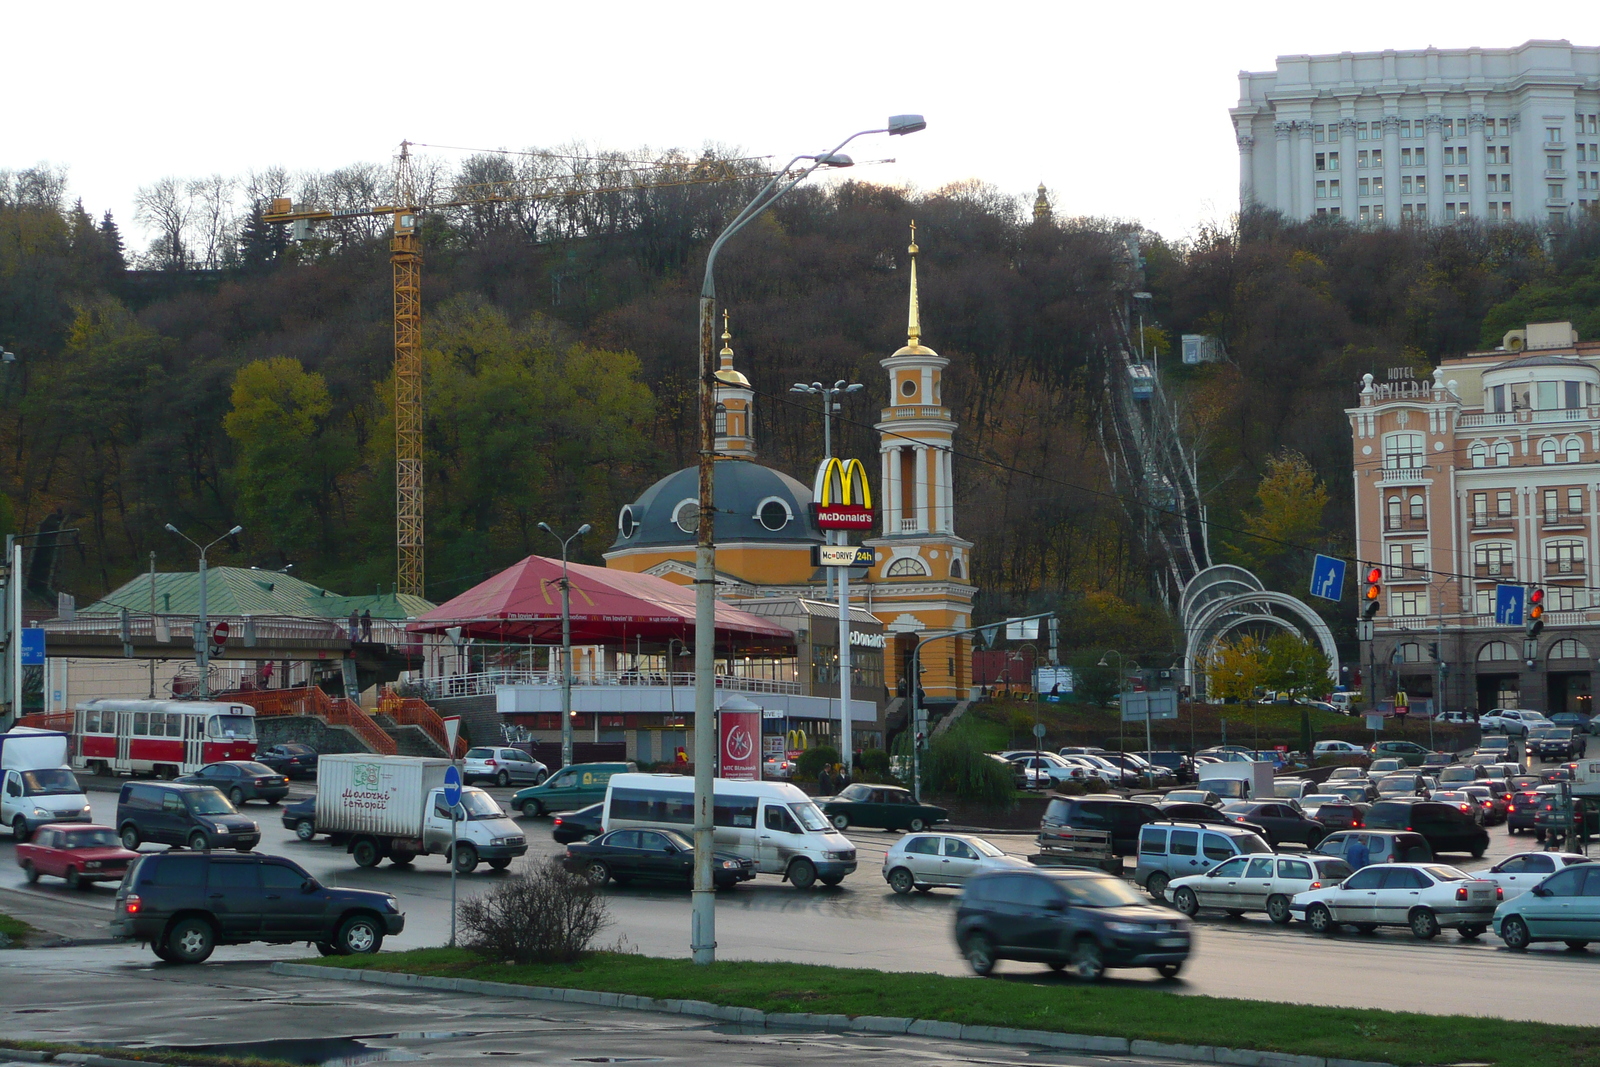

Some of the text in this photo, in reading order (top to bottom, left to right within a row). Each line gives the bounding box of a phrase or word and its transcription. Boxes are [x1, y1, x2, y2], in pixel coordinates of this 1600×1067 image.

[818, 513, 872, 522] McDonald's
[856, 551, 872, 561] 24h
[849, 630, 887, 648] cDonald's
[342, 788, 390, 800] Молочні
[344, 798, 386, 811] історії
